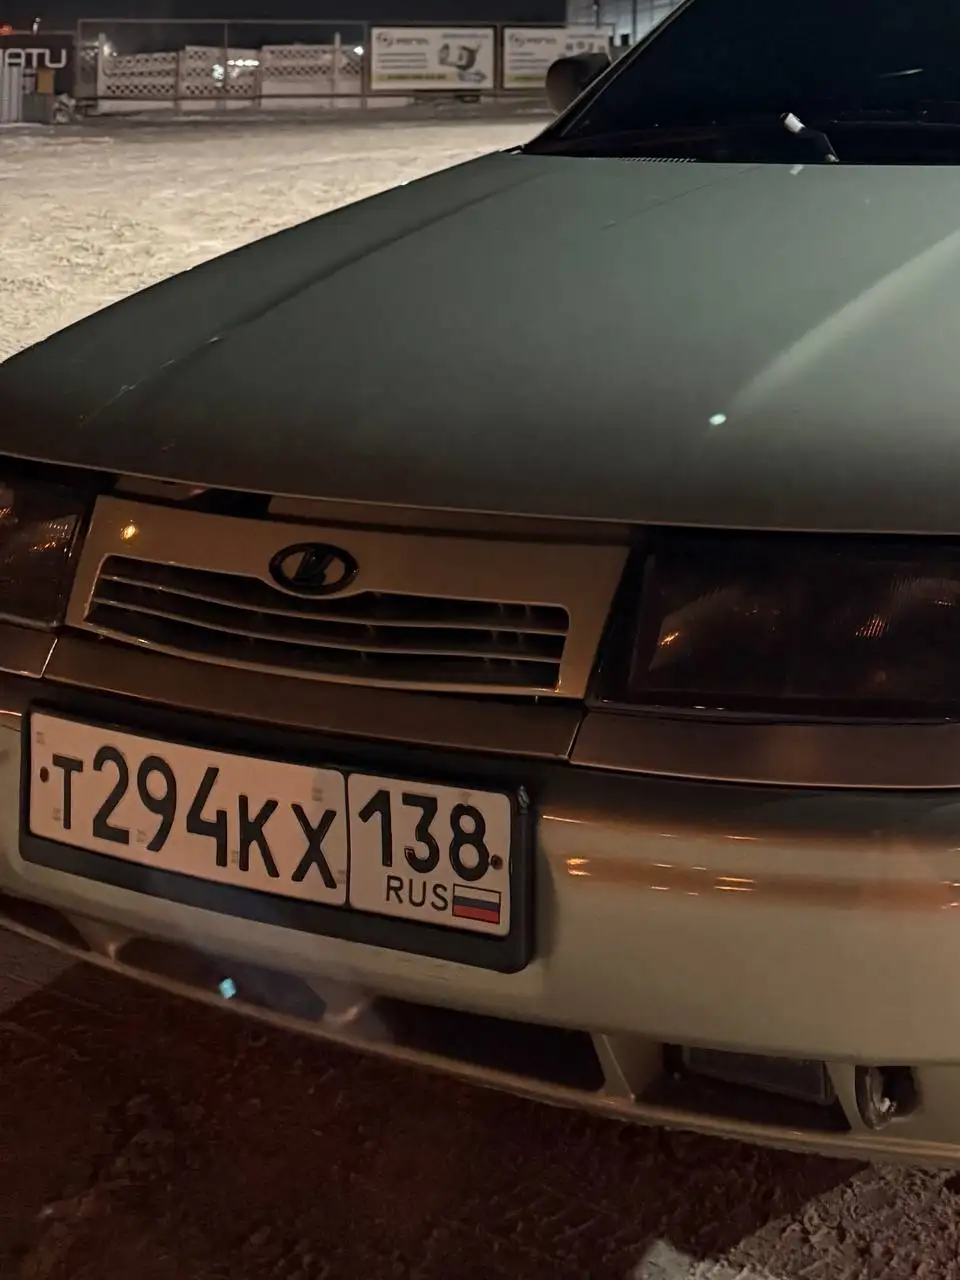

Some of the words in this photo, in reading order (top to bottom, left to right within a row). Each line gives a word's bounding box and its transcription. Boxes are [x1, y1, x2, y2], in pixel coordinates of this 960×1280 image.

[0, 48, 67, 69] ATU
[52, 745, 338, 889] T294KX
[358, 789, 490, 882] 138
[385, 875, 450, 913] RUS
